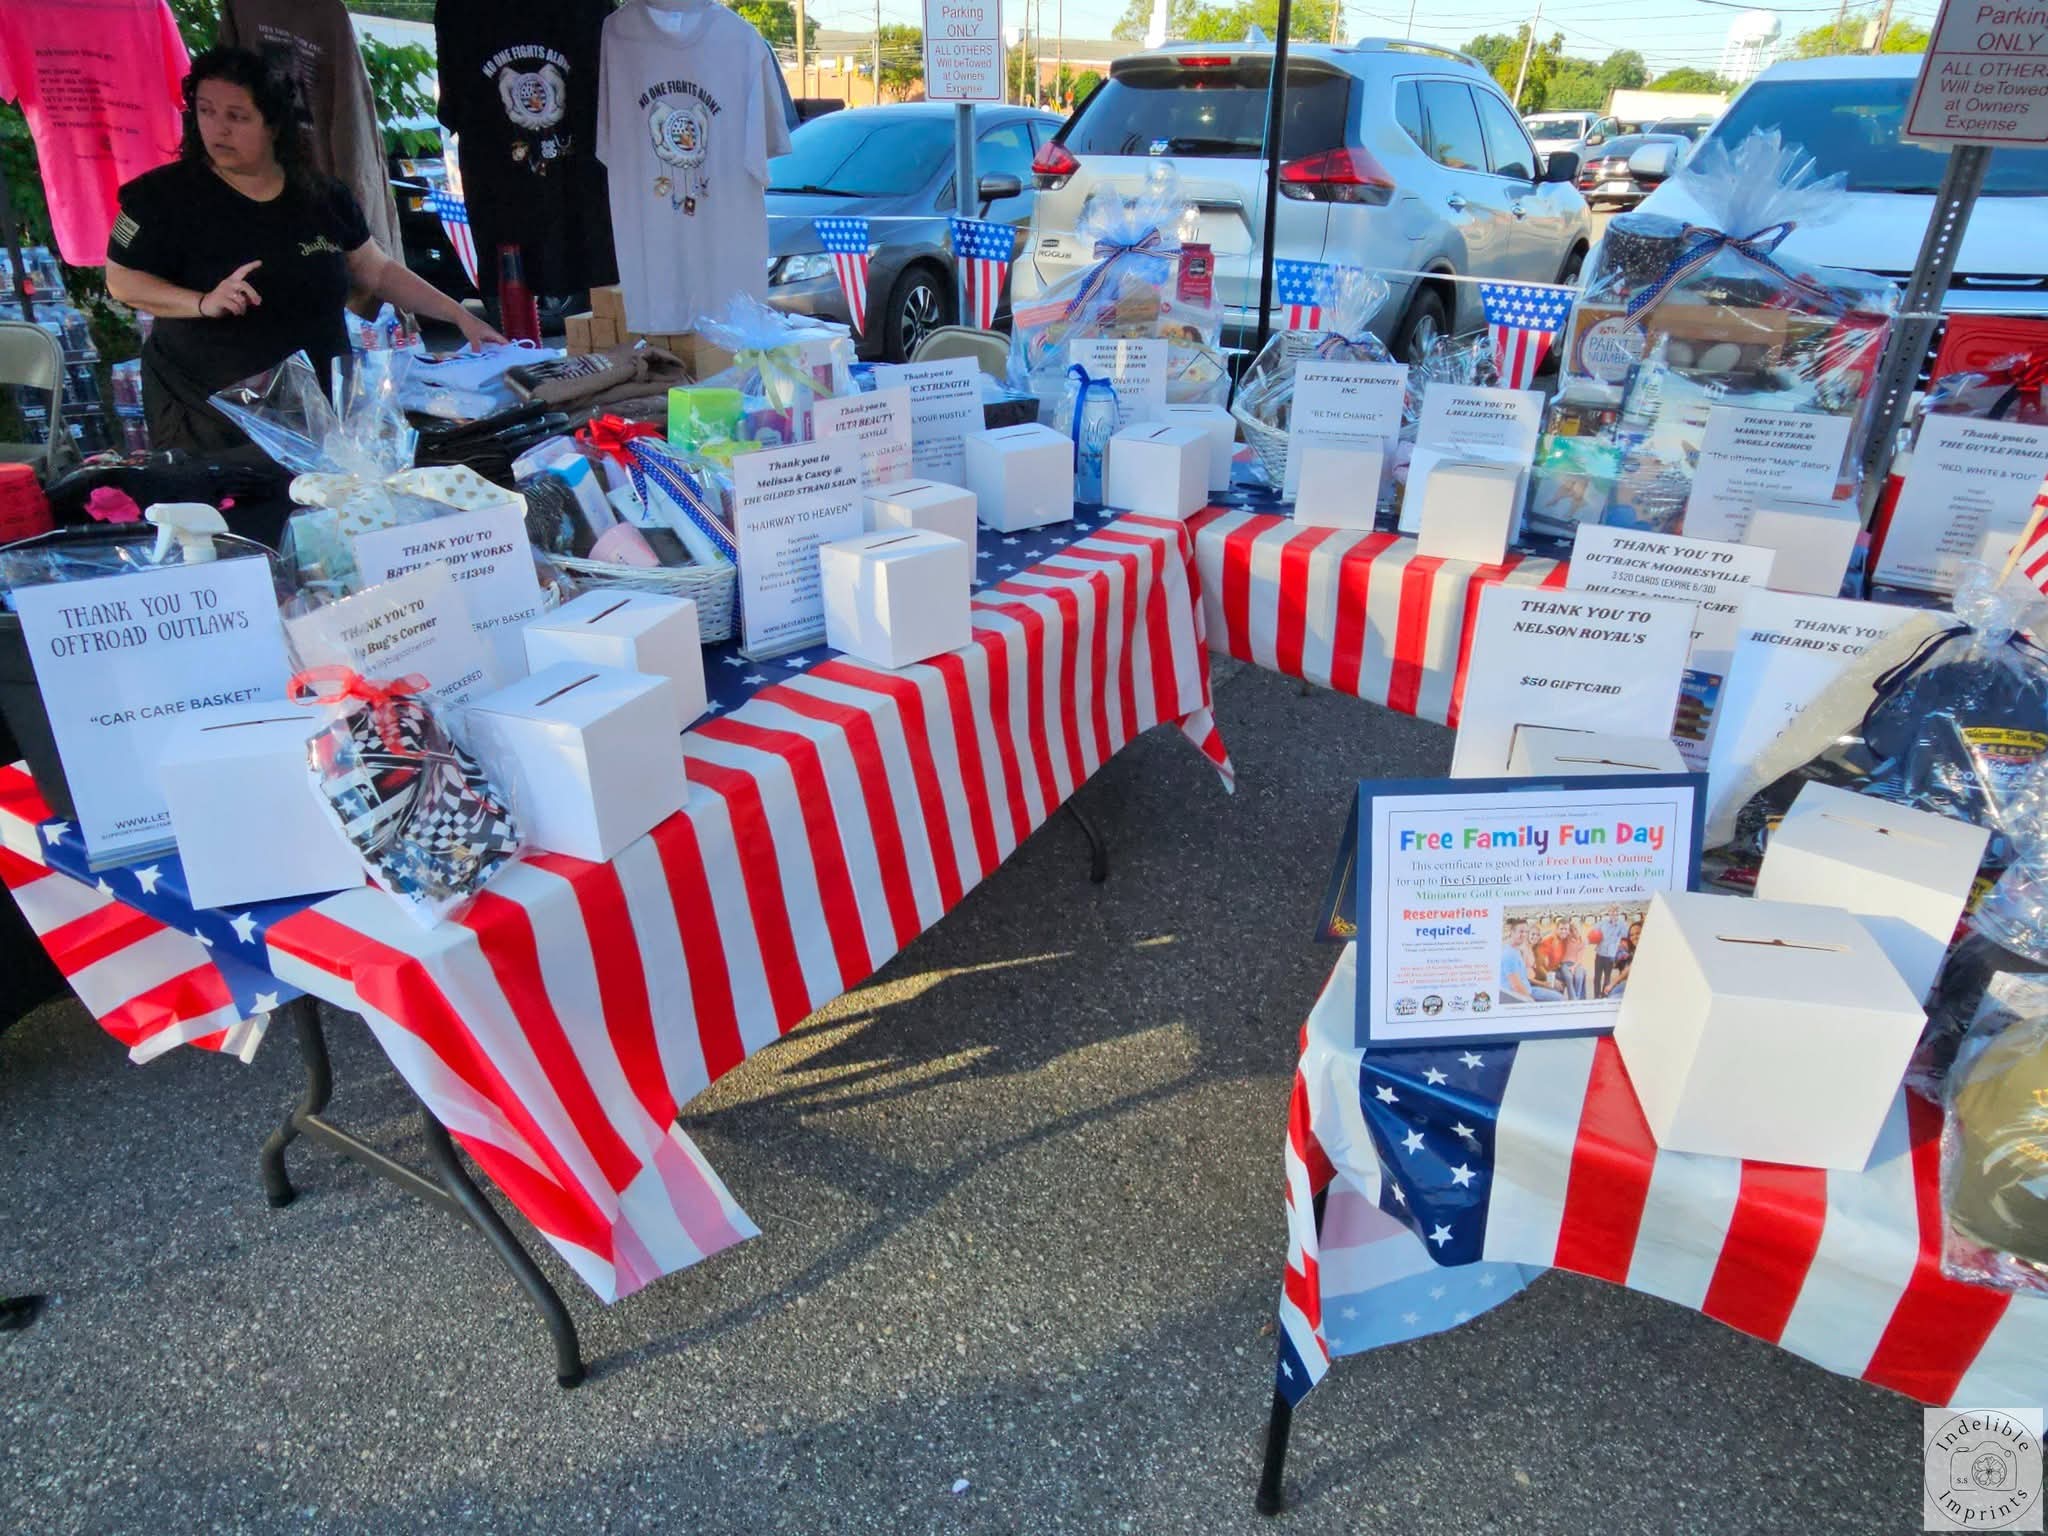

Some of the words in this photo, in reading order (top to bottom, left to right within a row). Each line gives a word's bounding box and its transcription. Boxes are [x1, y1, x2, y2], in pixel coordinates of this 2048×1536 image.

[942, 6, 983, 21] Parking
[947, 24, 979, 37] ONLY
[1977, 32, 2044, 51] ONLY
[936, 45, 951, 55] ALL
[954, 45, 992, 55] OTHERS
[482, 61, 497, 79] NO
[492, 50, 513, 68] ONE
[510, 44, 546, 62] FIGHTS
[936, 58, 952, 68] Will
[964, 57, 992, 68] Towed
[1941, 61, 1972, 76] ALL
[943, 72, 950, 80] at
[953, 71, 985, 80] Owners
[946, 83, 983, 93] Expense
[1941, 79, 1969, 93] Will
[1974, 80, 1993, 94] be
[638, 95, 651, 111] NO
[649, 83, 667, 101] ONE
[667, 79, 698, 97] FIGHTS
[698, 87, 722, 117] ALONE
[1944, 99, 1961, 111] at
[1965, 97, 2030, 113] Owners
[1945, 115, 2017, 131] Expense
[904, 371, 929, 380] Thank
[930, 370, 944, 378] you
[1304, 374, 1329, 382] LET'S
[1353, 377, 1399, 386] STRENGTH
[920, 379, 970, 392] STRENGTH
[840, 405, 865, 416] Thank
[865, 403, 879, 412] you
[1452, 399, 1482, 408] THANK
[1484, 401, 1503, 409] YOU
[858, 412, 895, 427] BEAUTY
[939, 410, 966, 420] HUSTLE
[1326, 410, 1340, 418] THE
[1446, 408, 1468, 416] LAKE
[1469, 411, 1518, 420] LIFESTYLE
[1744, 416, 1777, 426] THANK
[1777, 419, 1798, 428] YOU
[1733, 438, 1770, 447] ANGELA
[1734, 428, 1771, 437] MARINE
[1773, 431, 1817, 441] VETERAN
[1961, 429, 2001, 439] Thank
[2001, 434, 2023, 444] you
[2024, 437, 2038, 445] to
[1939, 440, 1964, 448] THE
[768, 458, 800, 471] Thank
[801, 455, 819, 466] you
[820, 454, 830, 462] to
[1730, 454, 1766, 464] ultimate
[1801, 459, 1832, 472] datory
[756, 475, 794, 489] Melissa
[805, 468, 832, 480] Casey
[1966, 466, 1998, 477] WHITE
[743, 495, 762, 506] THE
[763, 490, 795, 503] GILDED
[797, 482, 830, 495] STRAND
[832, 477, 858, 488] SALON
[798, 512, 809, 522] TO
[402, 539, 447, 557] THANK
[449, 534, 475, 547] YOU
[476, 530, 492, 541] TO
[471, 543, 514, 560] WORKS
[1612, 538, 1670, 555] THANK
[1672, 545, 1708, 560] YOU
[1711, 552, 1734, 563] TO
[460, 565, 495, 580] #1349
[1585, 552, 1650, 569] OUTBACK
[1651, 561, 1752, 584] MOORESVILLE
[1612, 571, 1618, 580] 3
[1618, 572, 1633, 582] $20
[1635, 574, 1660, 587] CARDS
[1661, 577, 1692, 591] (EXPIRE
[1692, 581, 1717, 594] 6/30)
[58, 600, 134, 630] THANK
[140, 592, 182, 618] YOU
[190, 588, 218, 610] TO
[383, 605, 408, 624] YOU
[409, 600, 425, 613] TO
[1521, 600, 1583, 617] THANK
[1586, 606, 1625, 621] YOU
[1627, 611, 1652, 624] TO
[1703, 600, 1738, 614] CAFE
[502, 608, 536, 625] BASKET
[50, 626, 148, 658] OFFROAD
[158, 610, 250, 641] OUTLAWS
[1513, 621, 1578, 637] NELSON
[1579, 628, 1648, 644] ROYAL'S
[1794, 619, 1852, 635] THANK
[367, 634, 399, 655] Bug's
[400, 617, 437, 640] Corner
[1750, 631, 1841, 653] RICHARD'S
[1520, 675, 1548, 687] $50
[1550, 679, 1622, 695] GIFTCARD
[90, 710, 137, 728] "CAR
[140, 700, 187, 720] CARE
[190, 687, 262, 710] BASKET"
[1400, 830, 1453, 851] Free
[1463, 824, 1549, 855] Family
[1559, 824, 1606, 846] Fun
[1616, 821, 1665, 851] Day
[1412, 861, 1431, 871] This
[1434, 859, 1483, 871] certificate
[1485, 860, 1493, 869] is
[1495, 859, 1519, 870] good
[1546, 856, 1569, 866] Free
[1572, 856, 1592, 865] Fun
[1595, 855, 1614, 866] Day
[1618, 854, 1653, 864] Outing
[1413, 879, 1426, 888] up
[1461, 874, 1475, 885] (5)
[1480, 874, 1512, 886] people
[1526, 871, 1562, 881] Victory
[1534, 887, 1553, 896] and
[1556, 887, 1575, 896] Fun
[1403, 907, 1489, 920] Reservations
[1415, 924, 1476, 939] required.
